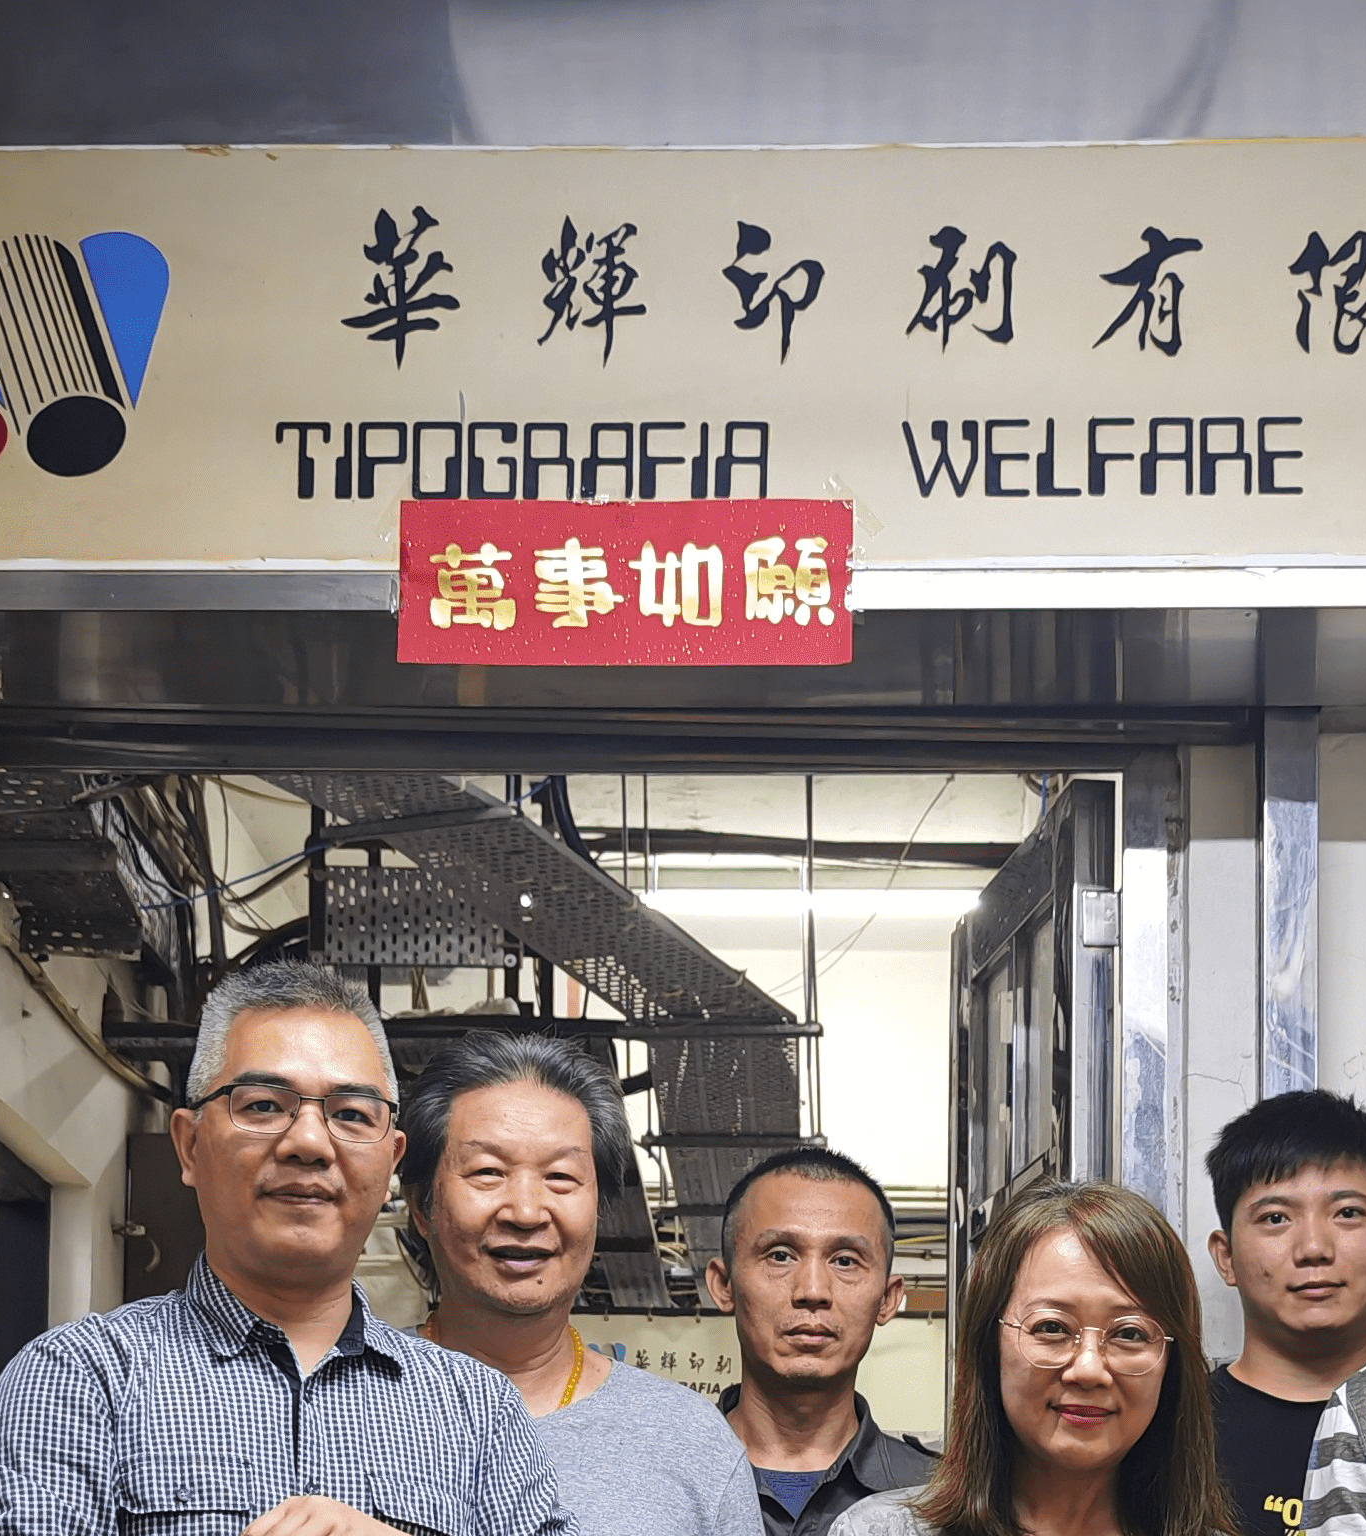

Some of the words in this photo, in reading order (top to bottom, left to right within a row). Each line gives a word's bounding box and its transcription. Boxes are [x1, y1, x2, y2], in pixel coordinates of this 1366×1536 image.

[275, 420, 770, 500] TIPOGRAFIA
[901, 417, 1304, 497] WELFARE
[429, 537, 835, 630] 萬事如願
